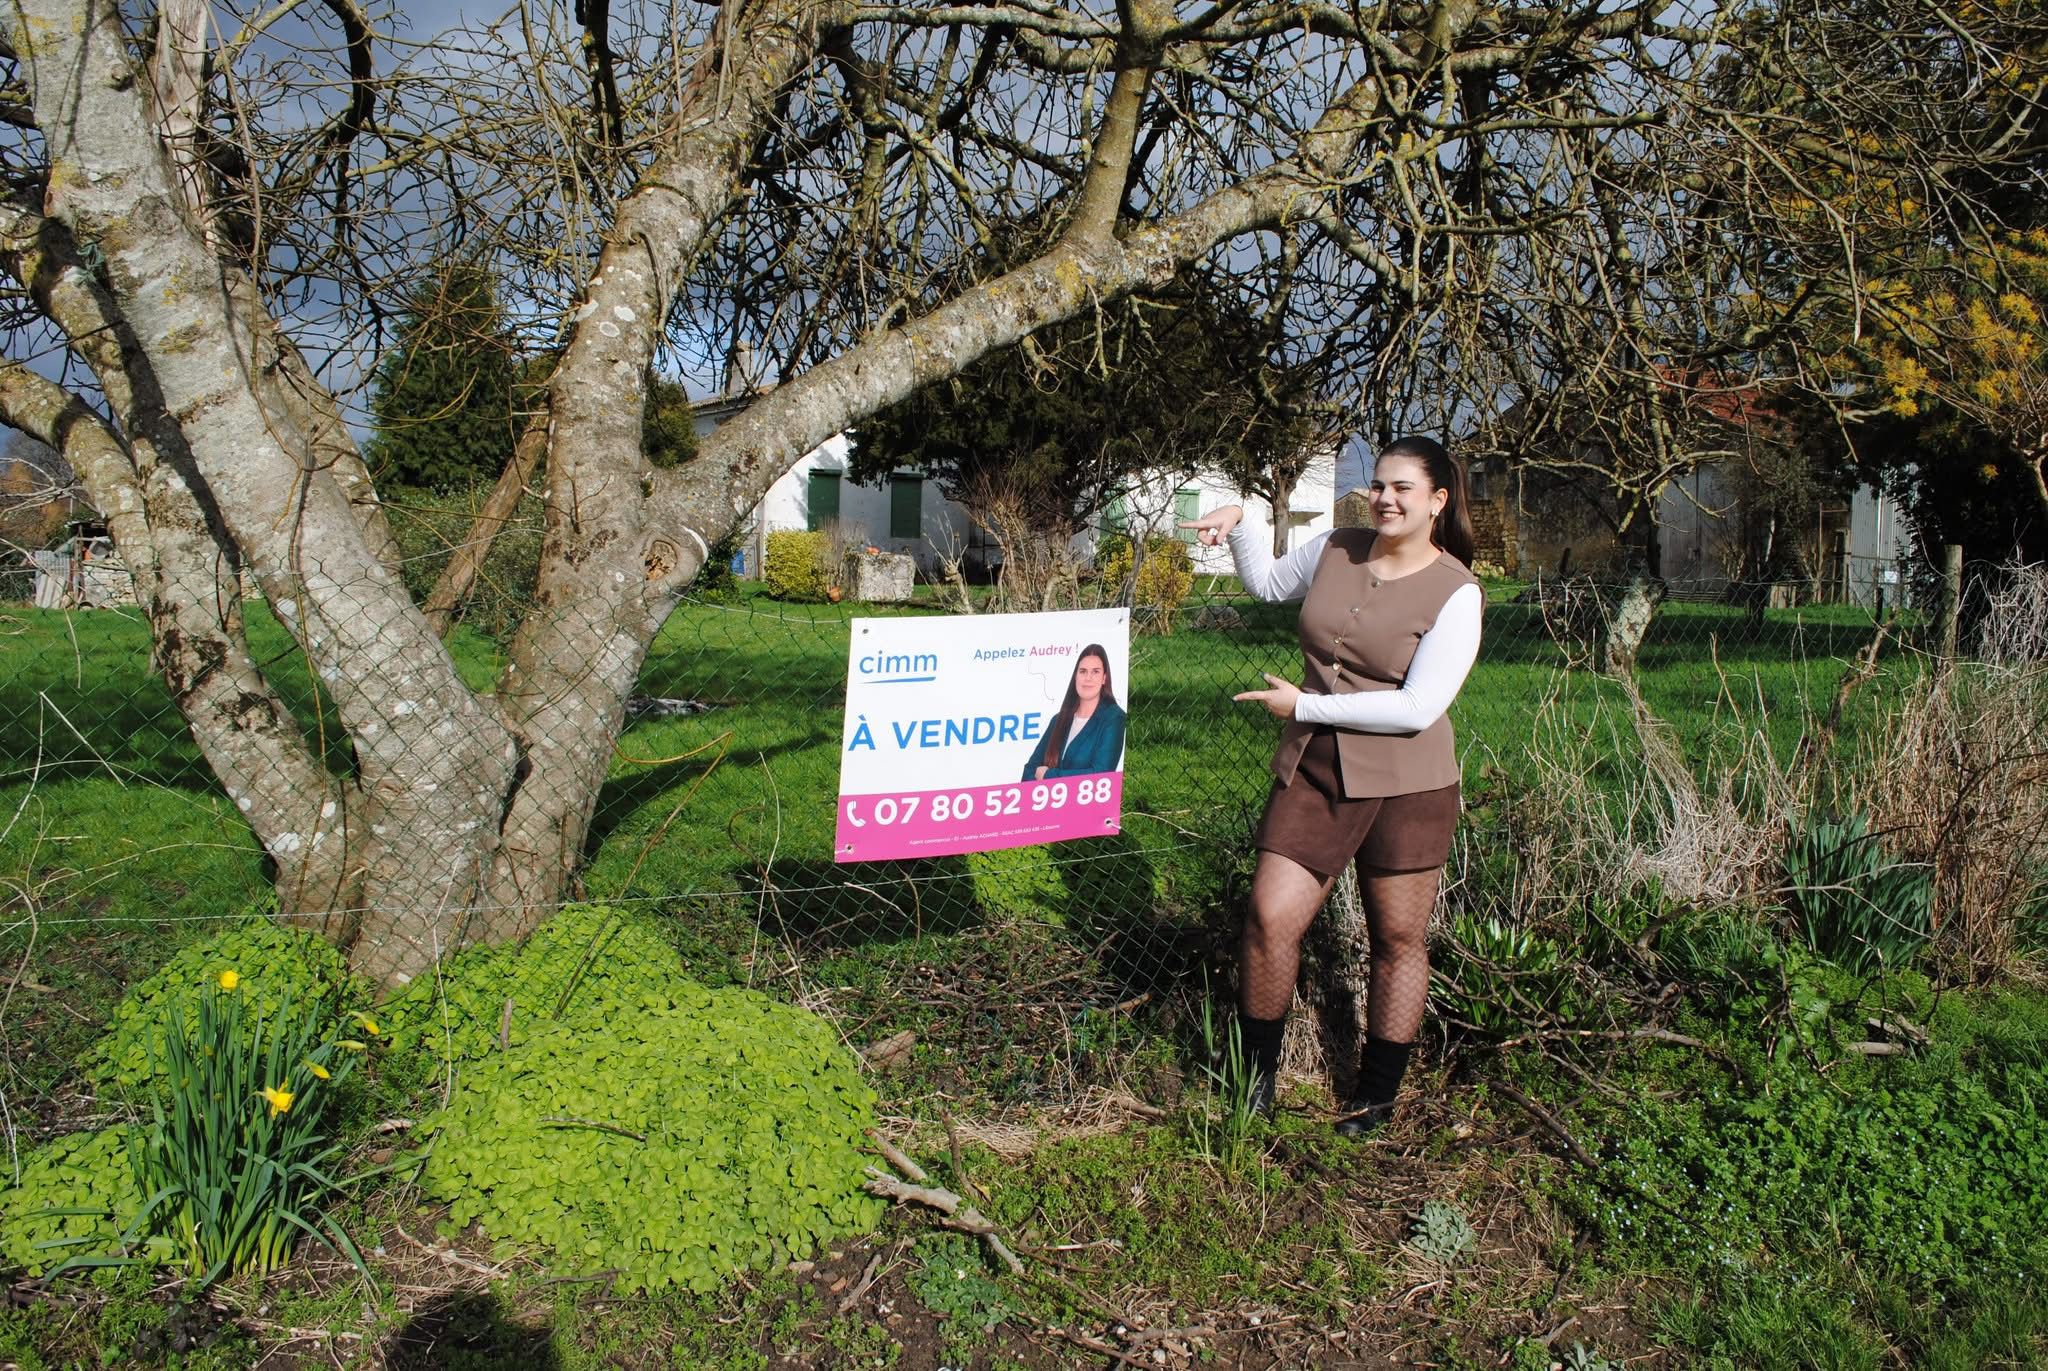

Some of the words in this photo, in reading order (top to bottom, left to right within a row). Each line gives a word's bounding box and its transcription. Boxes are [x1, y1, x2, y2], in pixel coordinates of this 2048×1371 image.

[859, 650, 938, 674] cimm
[974, 648, 1025, 661] Appelez
[1030, 645, 1072, 657] Audrey
[848, 714, 876, 751] À
[892, 712, 1041, 749] VENDRE
[874, 797, 920, 825] 07
[930, 793, 974, 822] 80
[984, 788, 1022, 817] 52
[1031, 782, 1068, 811] 99
[1077, 778, 1112, 805] 88
